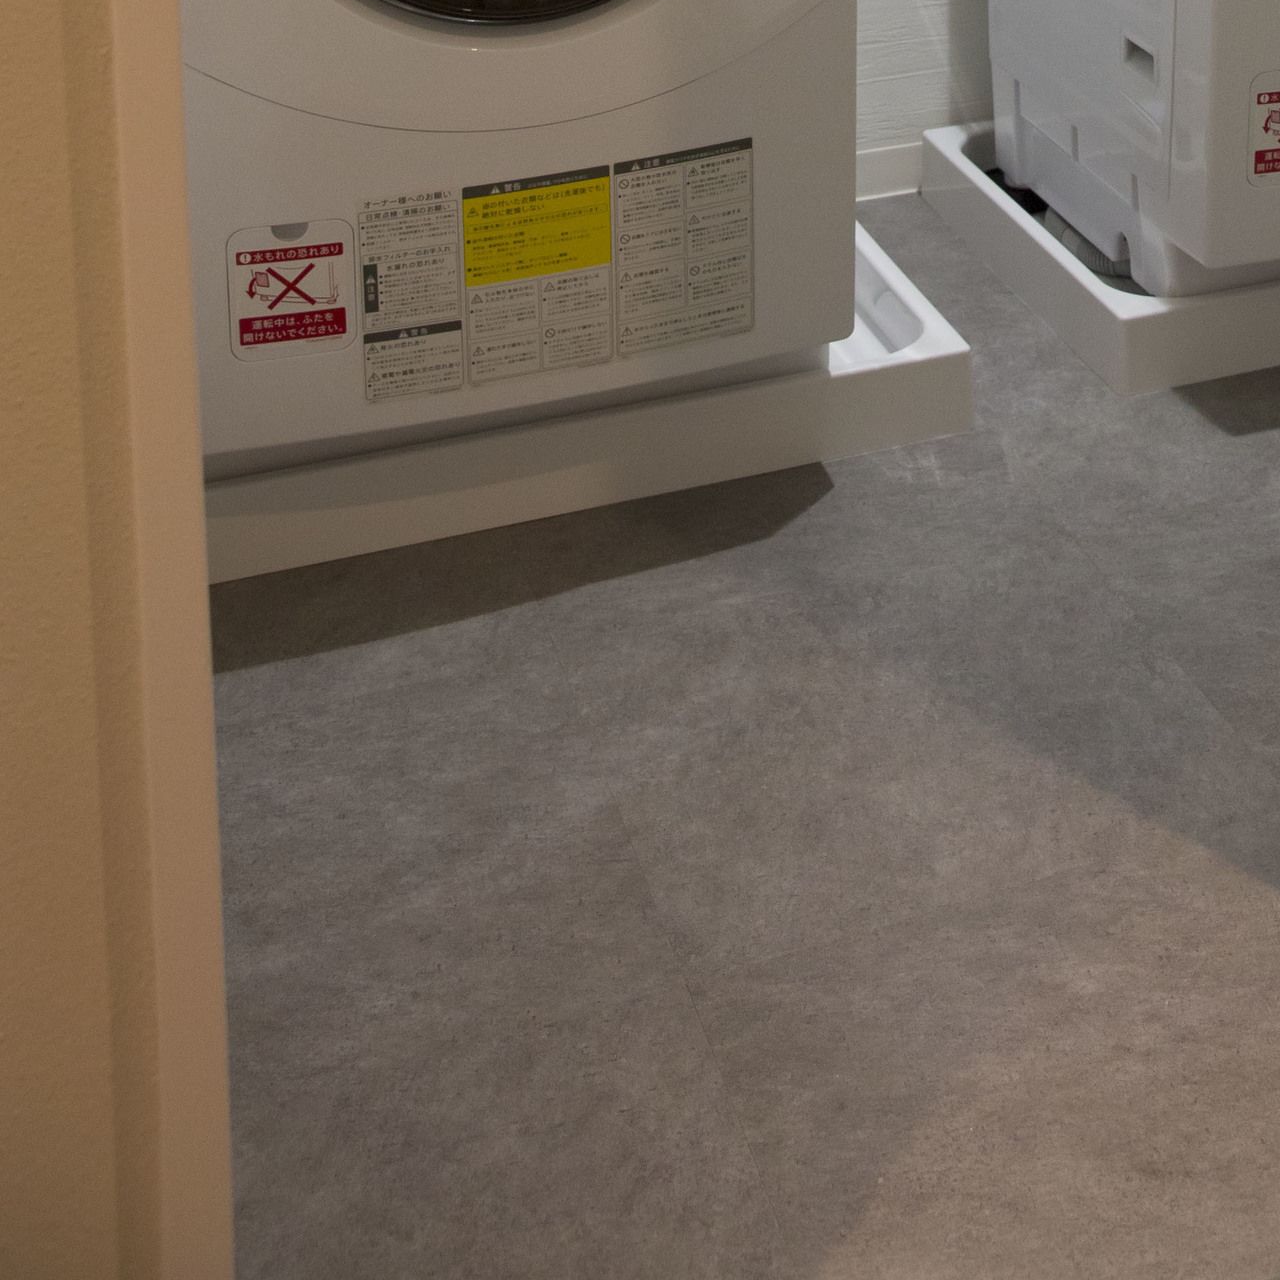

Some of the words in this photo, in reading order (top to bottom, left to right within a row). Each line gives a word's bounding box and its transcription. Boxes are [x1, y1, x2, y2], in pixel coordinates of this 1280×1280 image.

[363, 192, 451, 210] オーナー様へのお願い
[253, 245, 340, 262] 水もれの恐れあり
[251, 314, 334, 330] 運転中は、ふたを
[243, 325, 343, 344] 開けないでください。
